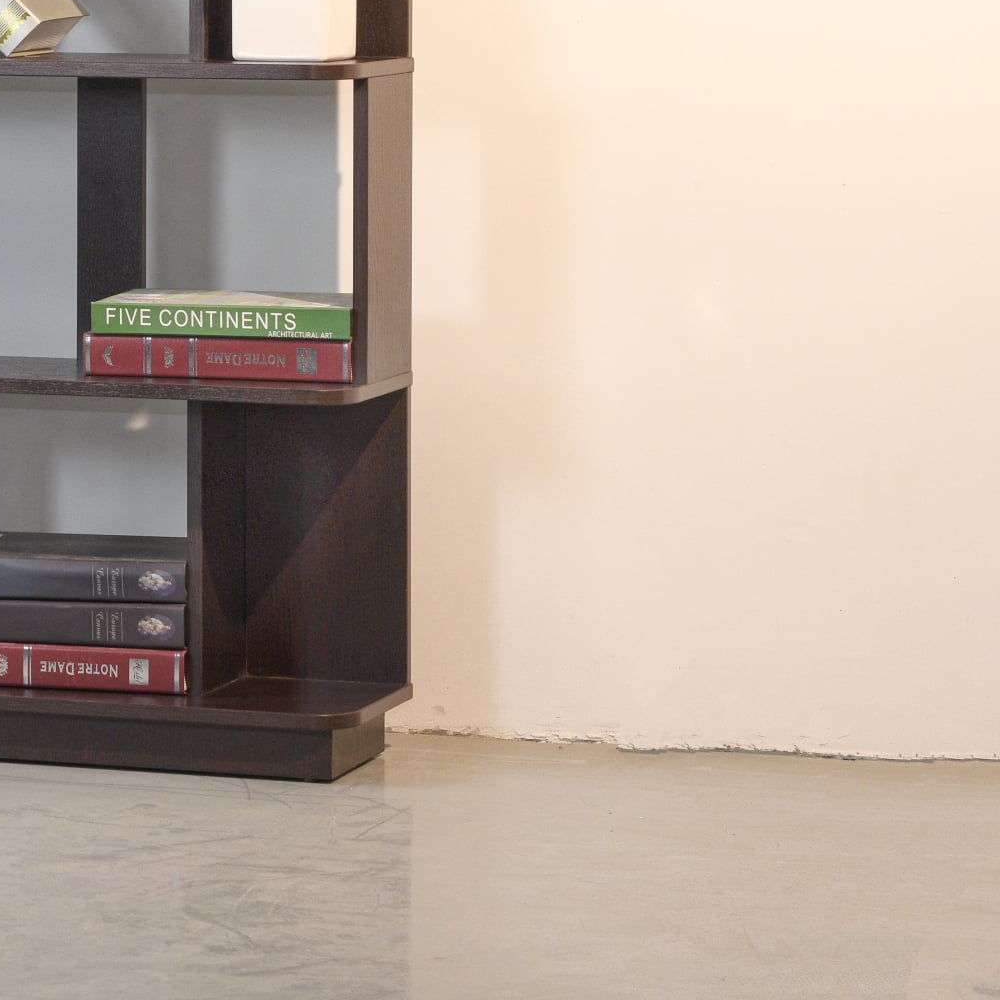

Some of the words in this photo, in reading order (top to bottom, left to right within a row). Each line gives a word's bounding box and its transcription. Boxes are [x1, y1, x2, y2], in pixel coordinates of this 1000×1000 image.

[105, 308, 152, 326] FIVE
[158, 309, 297, 331] CONTINENTS
[267, 330, 319, 339] ARCHITECTURAL
[206, 352, 242, 366] DAME
[244, 354, 286, 368] NOTRE
[40, 660, 74, 676] DAME
[78, 664, 118, 678] NOTRE
